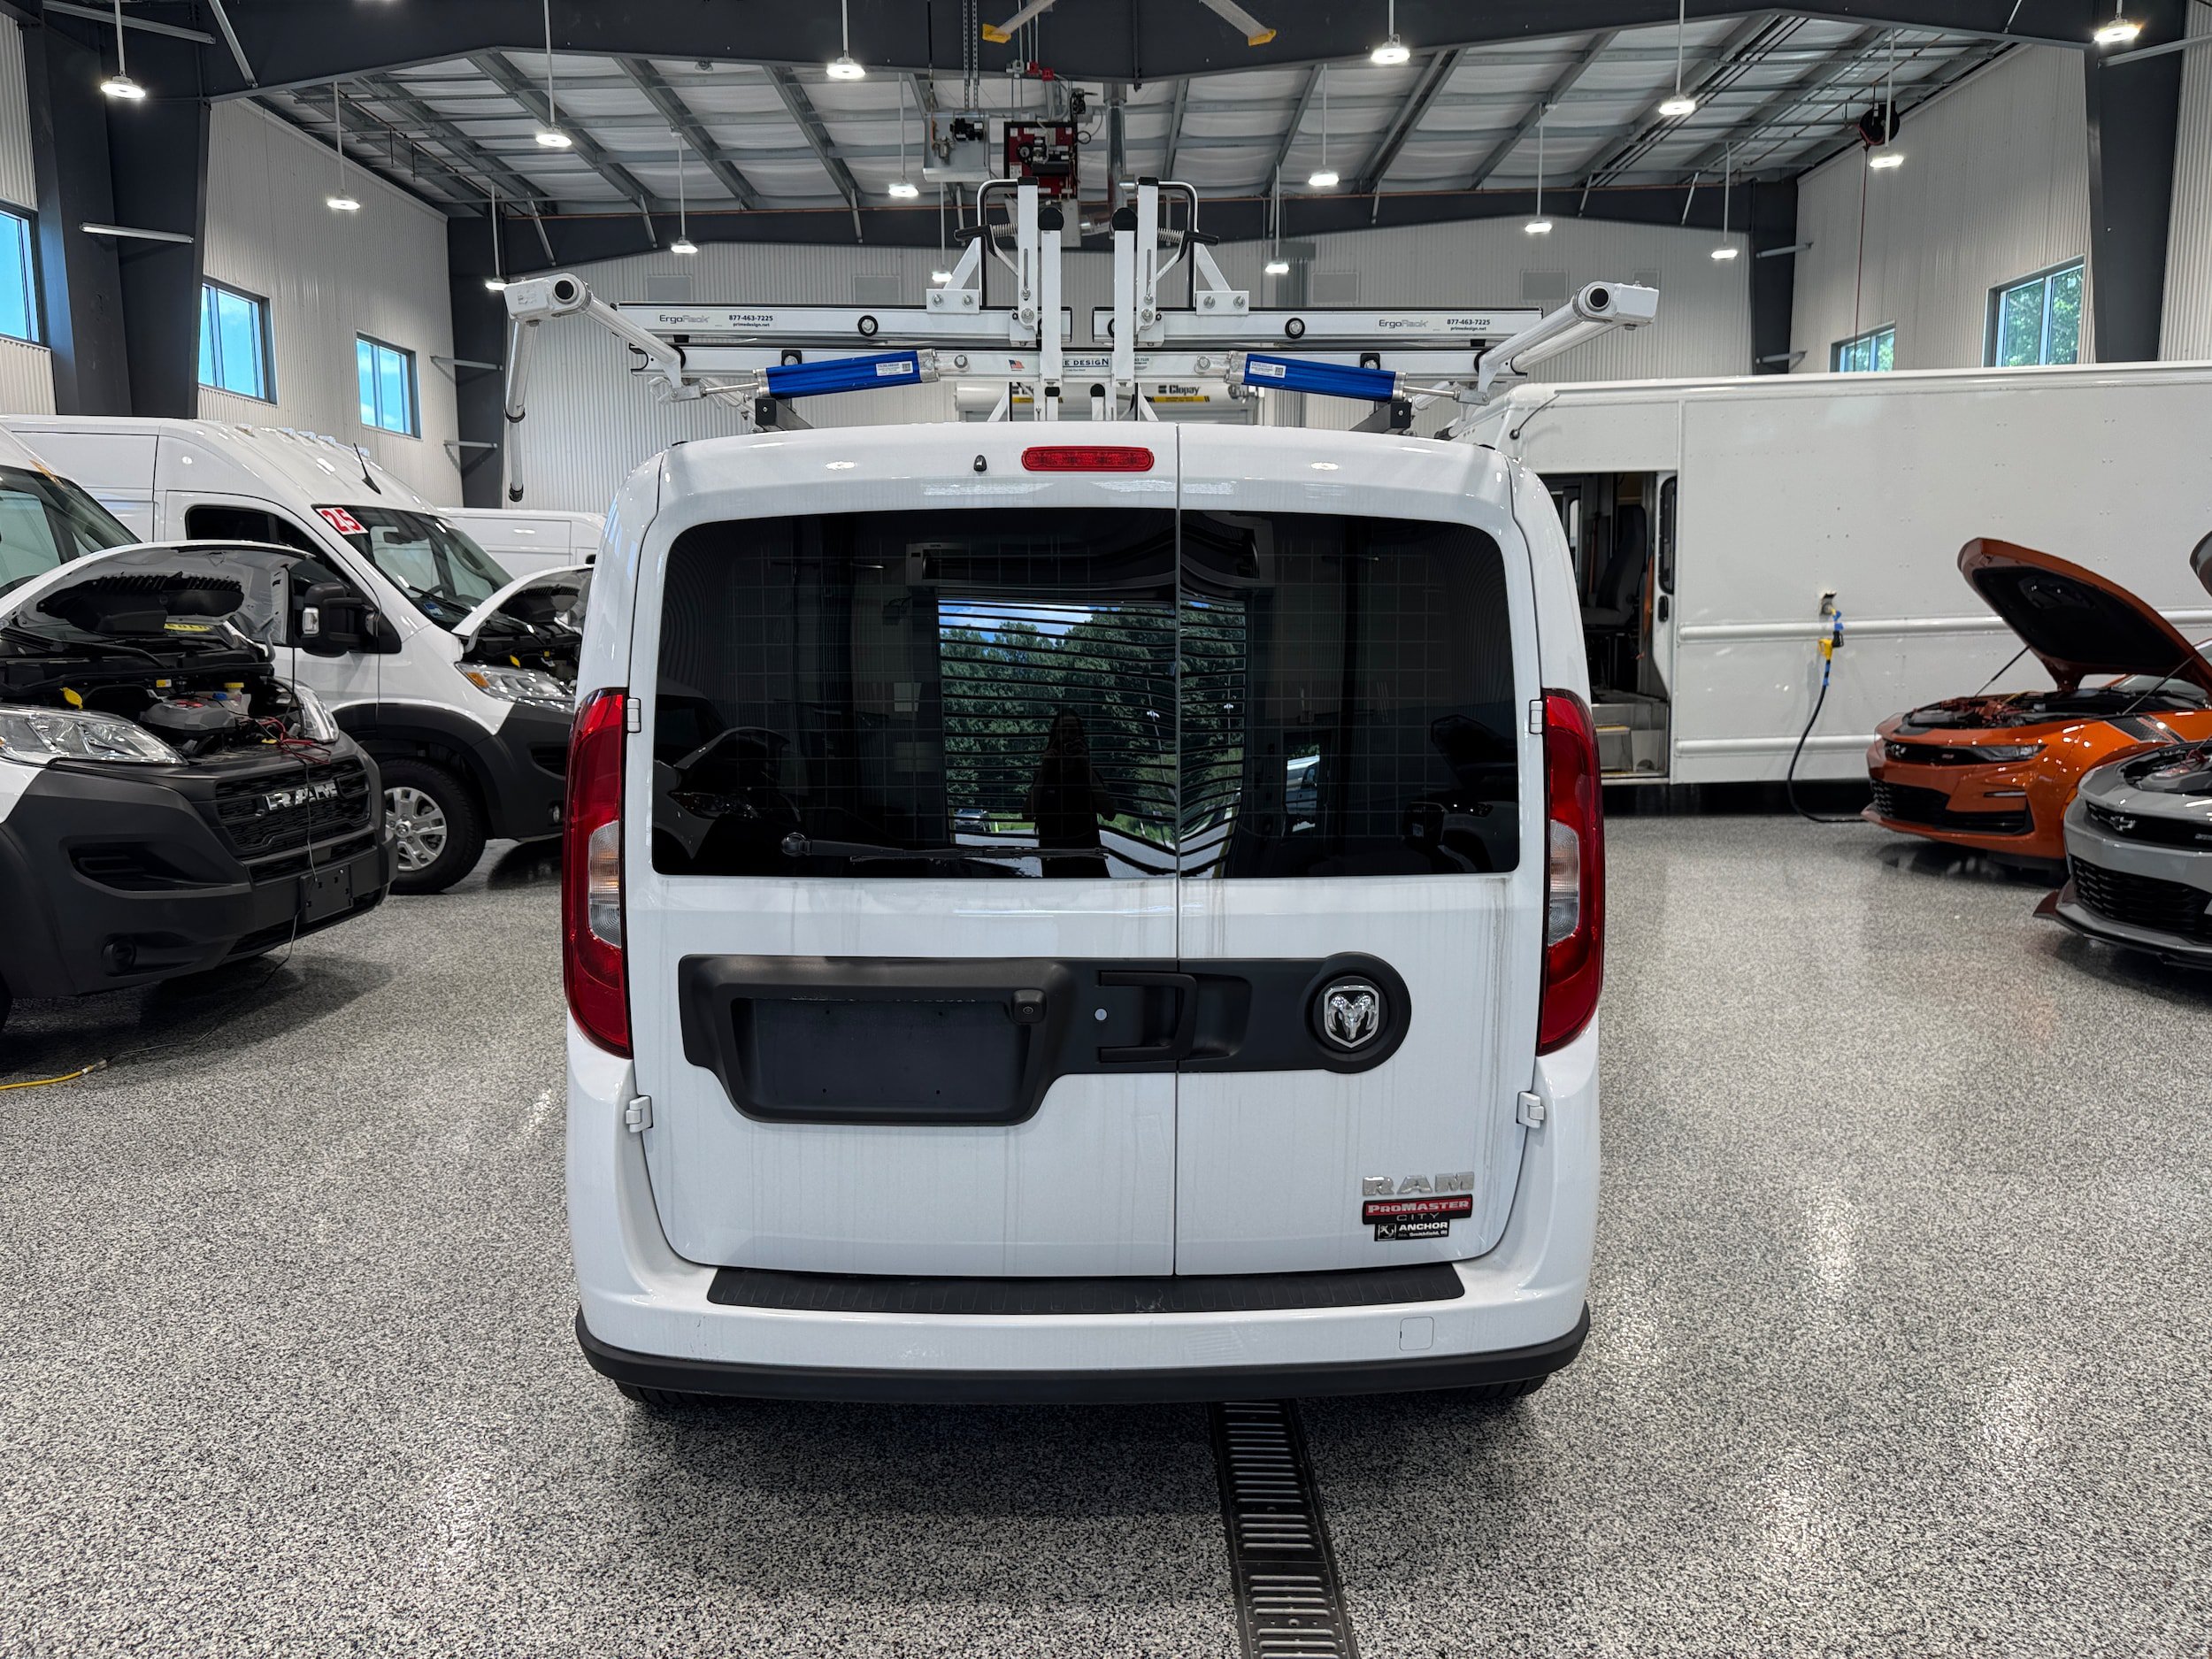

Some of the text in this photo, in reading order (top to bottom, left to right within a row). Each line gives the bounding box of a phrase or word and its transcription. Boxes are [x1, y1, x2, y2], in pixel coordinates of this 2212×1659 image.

[1379, 319, 1428, 329] ErgoRack
[1169, 384, 1201, 396] Clopay
[320, 509, 361, 532] 25
[265, 782, 338, 811] RAM
[1362, 1171, 1475, 1196] RAM
[1396, 1212, 1440, 1221] CITY
[1399, 1222, 1448, 1231] ANCHOR
